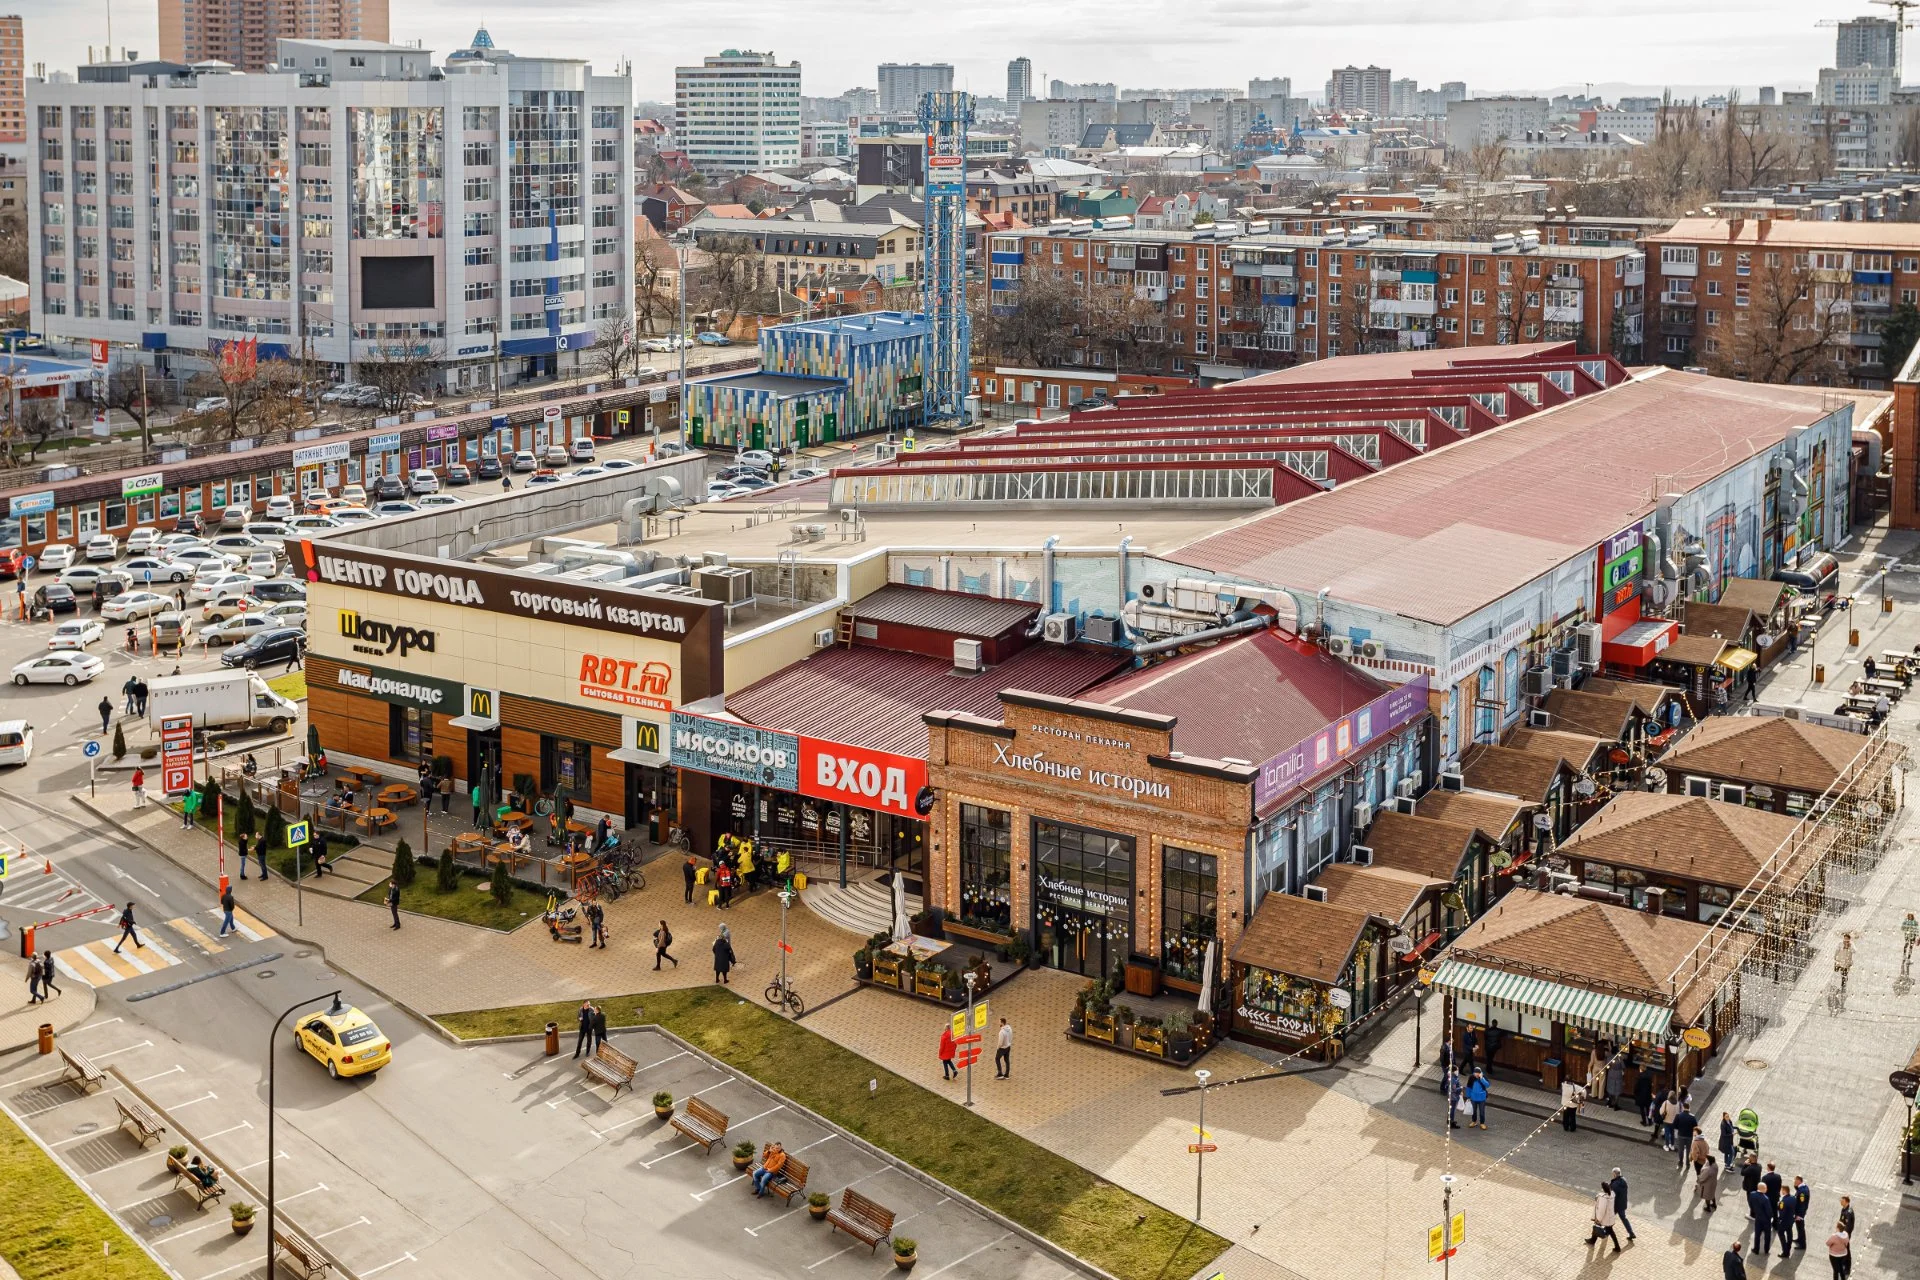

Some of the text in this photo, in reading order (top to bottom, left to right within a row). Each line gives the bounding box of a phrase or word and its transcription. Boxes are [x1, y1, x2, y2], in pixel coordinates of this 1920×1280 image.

[544, 296, 566, 305] СОГАЗ
[458, 345, 489, 355] СОГАЗ
[294, 448, 324, 462] НАТЯЖНЫЕ
[324, 443, 349, 457] ПОТОЛКИ
[370, 434, 400, 446] КЛЮЧИ
[135, 476, 159, 489] CDEK
[318, 555, 485, 605] ЦЕНТР ГОРОДА
[510, 590, 686, 634] торговый квартал
[338, 608, 436, 658] Шатура
[353, 644, 385, 657] МЕБЕЛЬ
[337, 668, 444, 706] Макдоналдс
[579, 653, 667, 694] RBT.ru
[583, 686, 667, 711] БЫТОВАЯ ТЕХНИКА
[1031, 723, 1132, 751] РЕСТОРАН ПЕКАРНЯ
[817, 752, 908, 811] ВХОД
[992, 742, 1171, 800] Хлебные истории
[1038, 874, 1128, 907] Хлебные истории
[1049, 892, 1115, 912] РЕСТОРАН ПЕКАРНЯ
